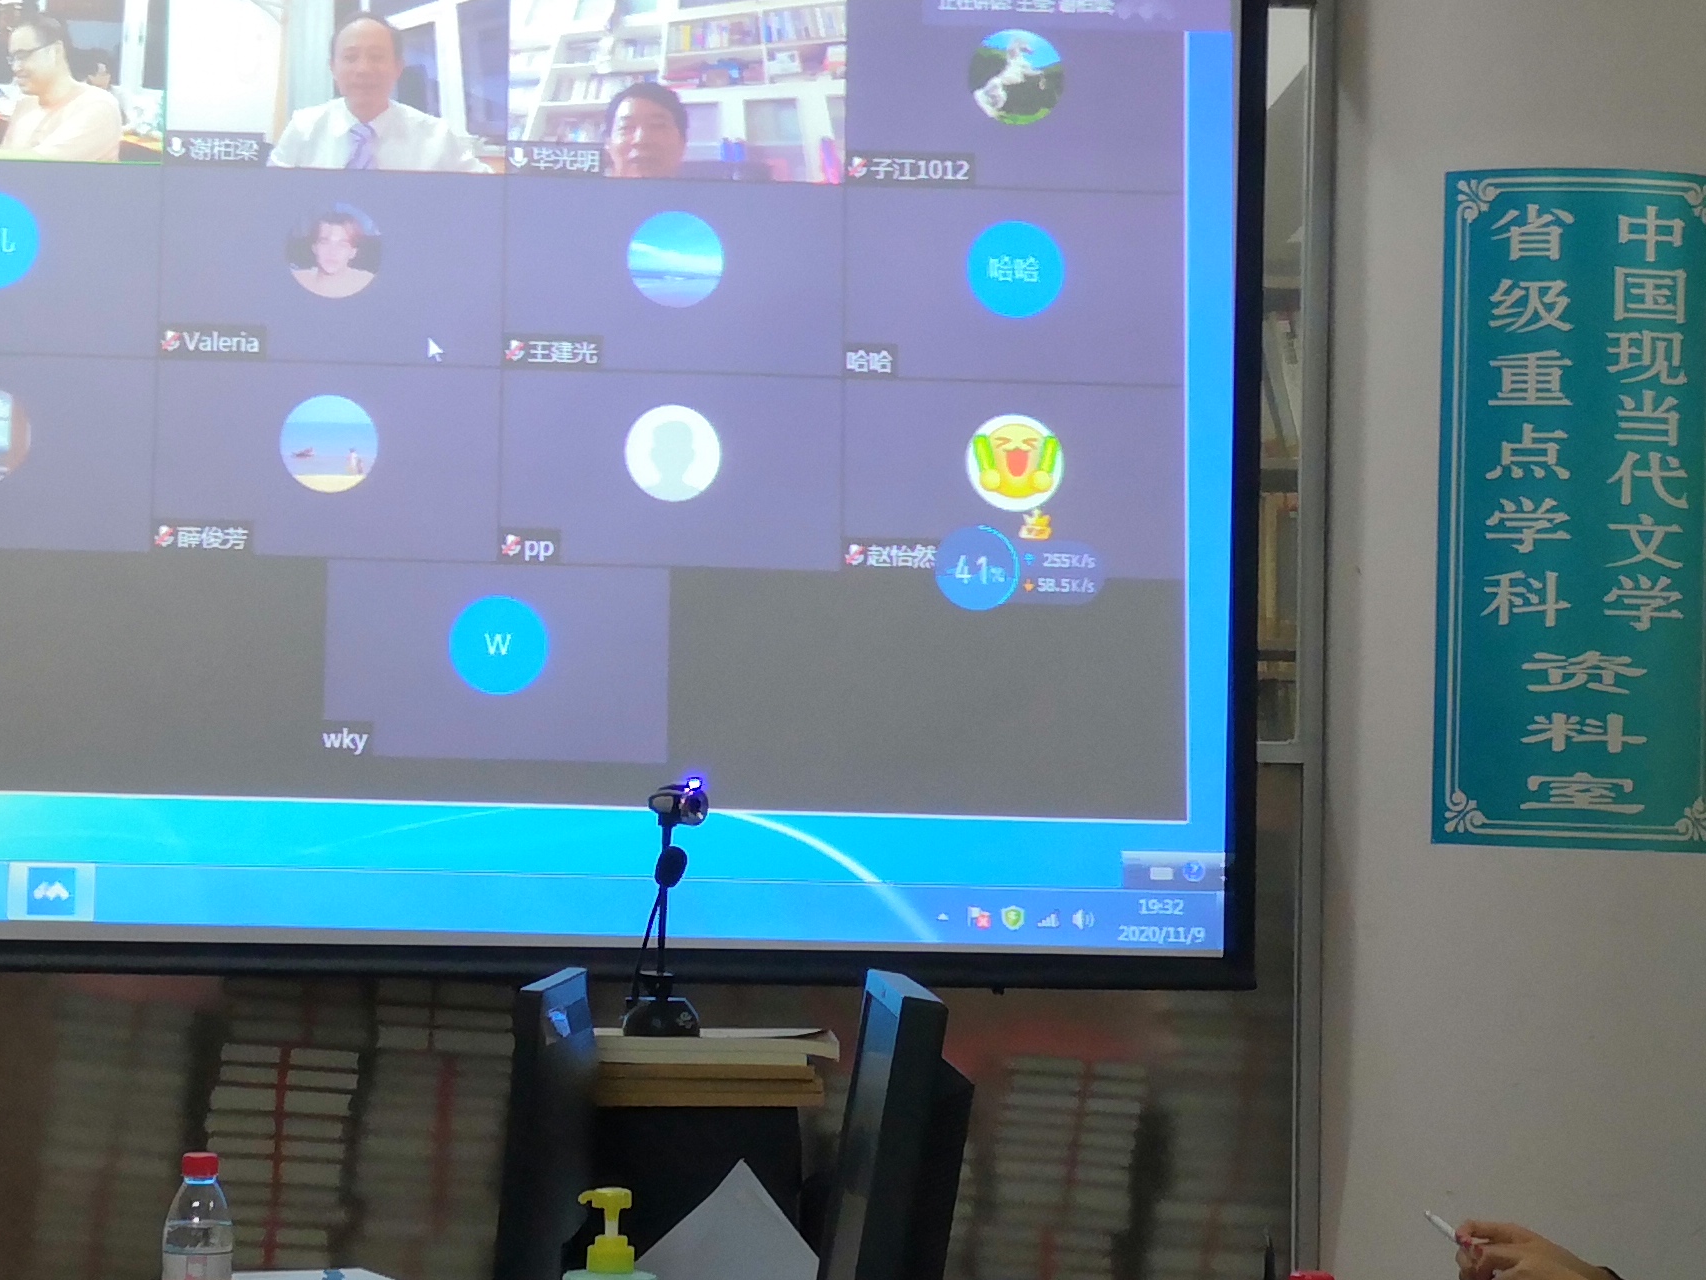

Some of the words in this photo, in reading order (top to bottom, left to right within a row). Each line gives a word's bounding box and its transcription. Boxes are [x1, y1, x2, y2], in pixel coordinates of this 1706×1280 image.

[531, 148, 600, 173] 毕光明
[870, 157, 971, 182] 子江1012
[987, 255, 1041, 285] 哈哈
[183, 330, 261, 353] Valeria
[527, 340, 599, 365] 王建光
[846, 349, 893, 375] 哈哈
[1480, 203, 1576, 628] 省级重点学科
[1602, 205, 1690, 632] 中国现当代文学
[524, 539, 555, 562] pp
[866, 543, 938, 571] 赵怡然
[1041, 552, 1096, 570] 255K/s
[322, 727, 369, 756] wky
[1519, 649, 1649, 816] 资料室
[1138, 898, 1184, 916] 19:32
[1117, 924, 1206, 945] 2020/11/9
